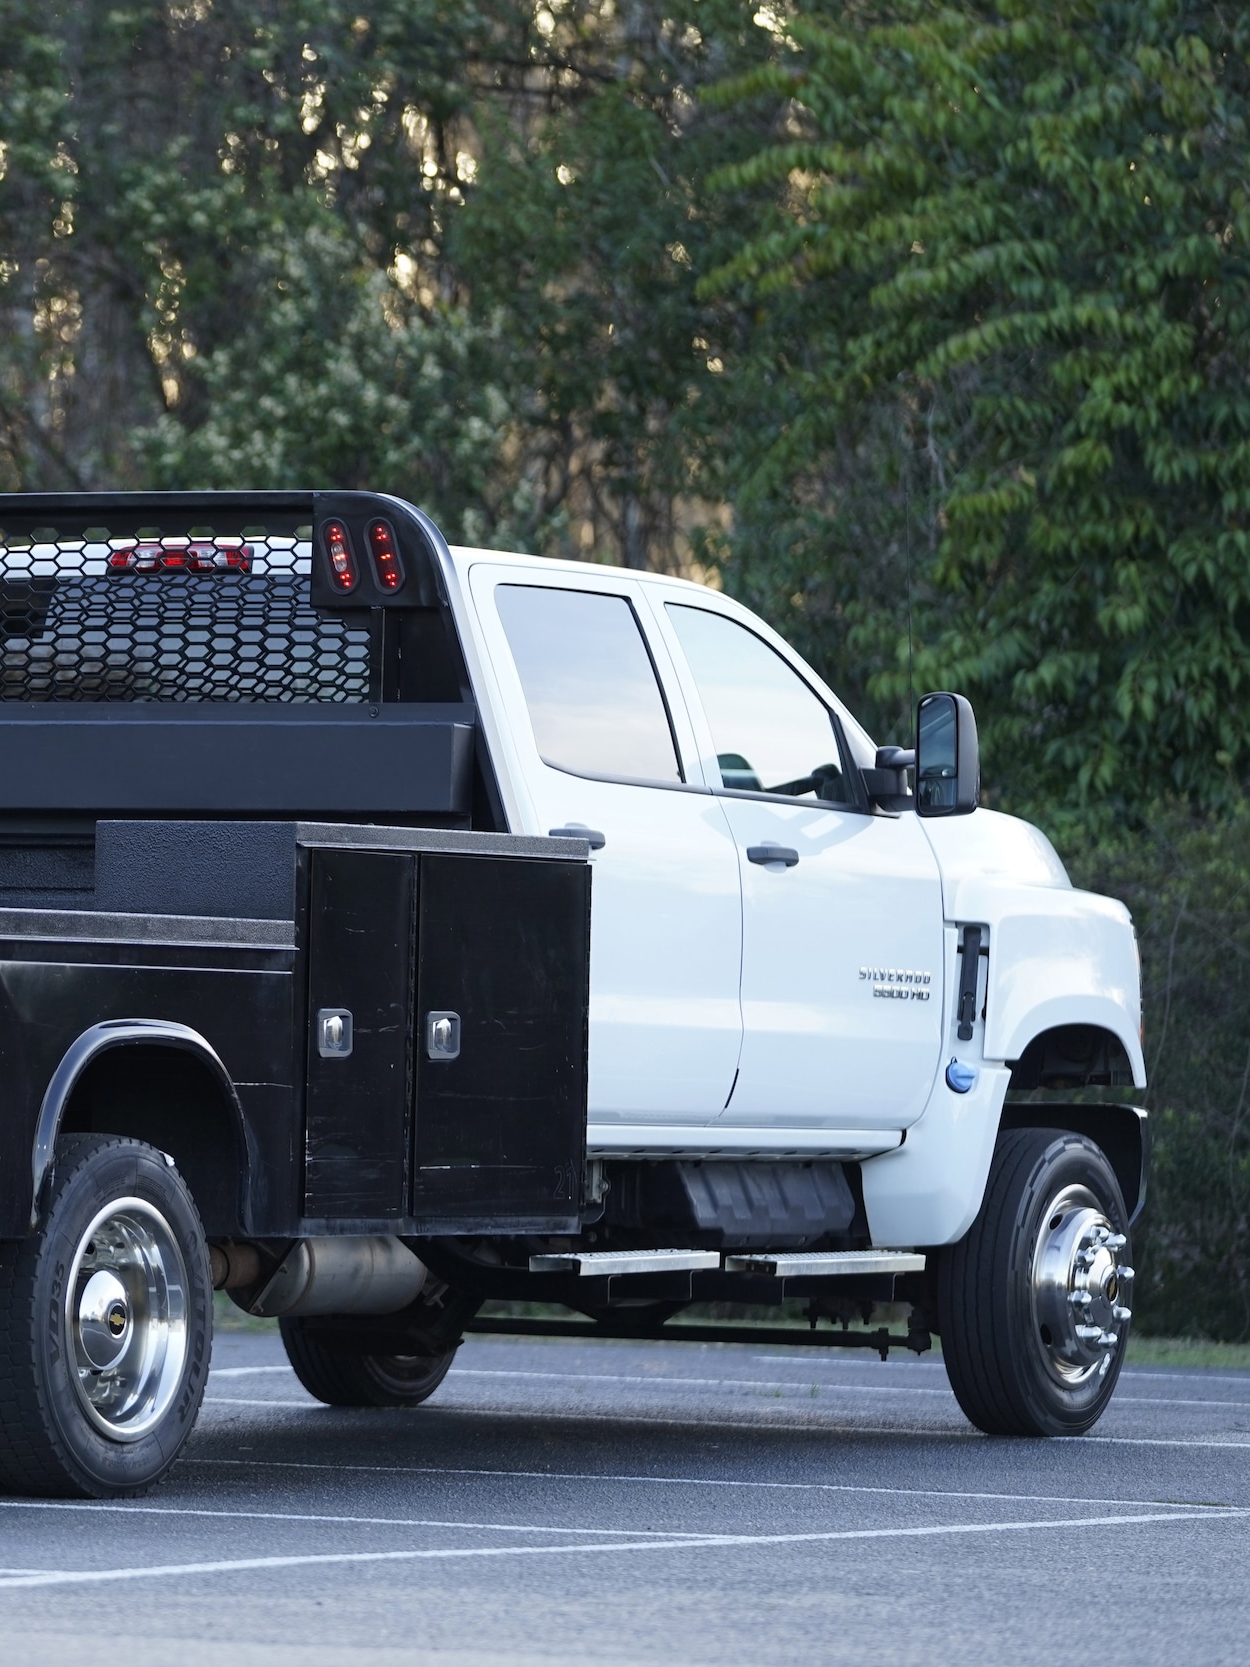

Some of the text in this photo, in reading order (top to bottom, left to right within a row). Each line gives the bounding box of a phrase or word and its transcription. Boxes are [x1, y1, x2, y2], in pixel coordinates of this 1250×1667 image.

[859, 967, 931, 984] SILVERADO
[873, 984, 930, 1001] 5500 HD
[48, 1260, 65, 1366] VD35
